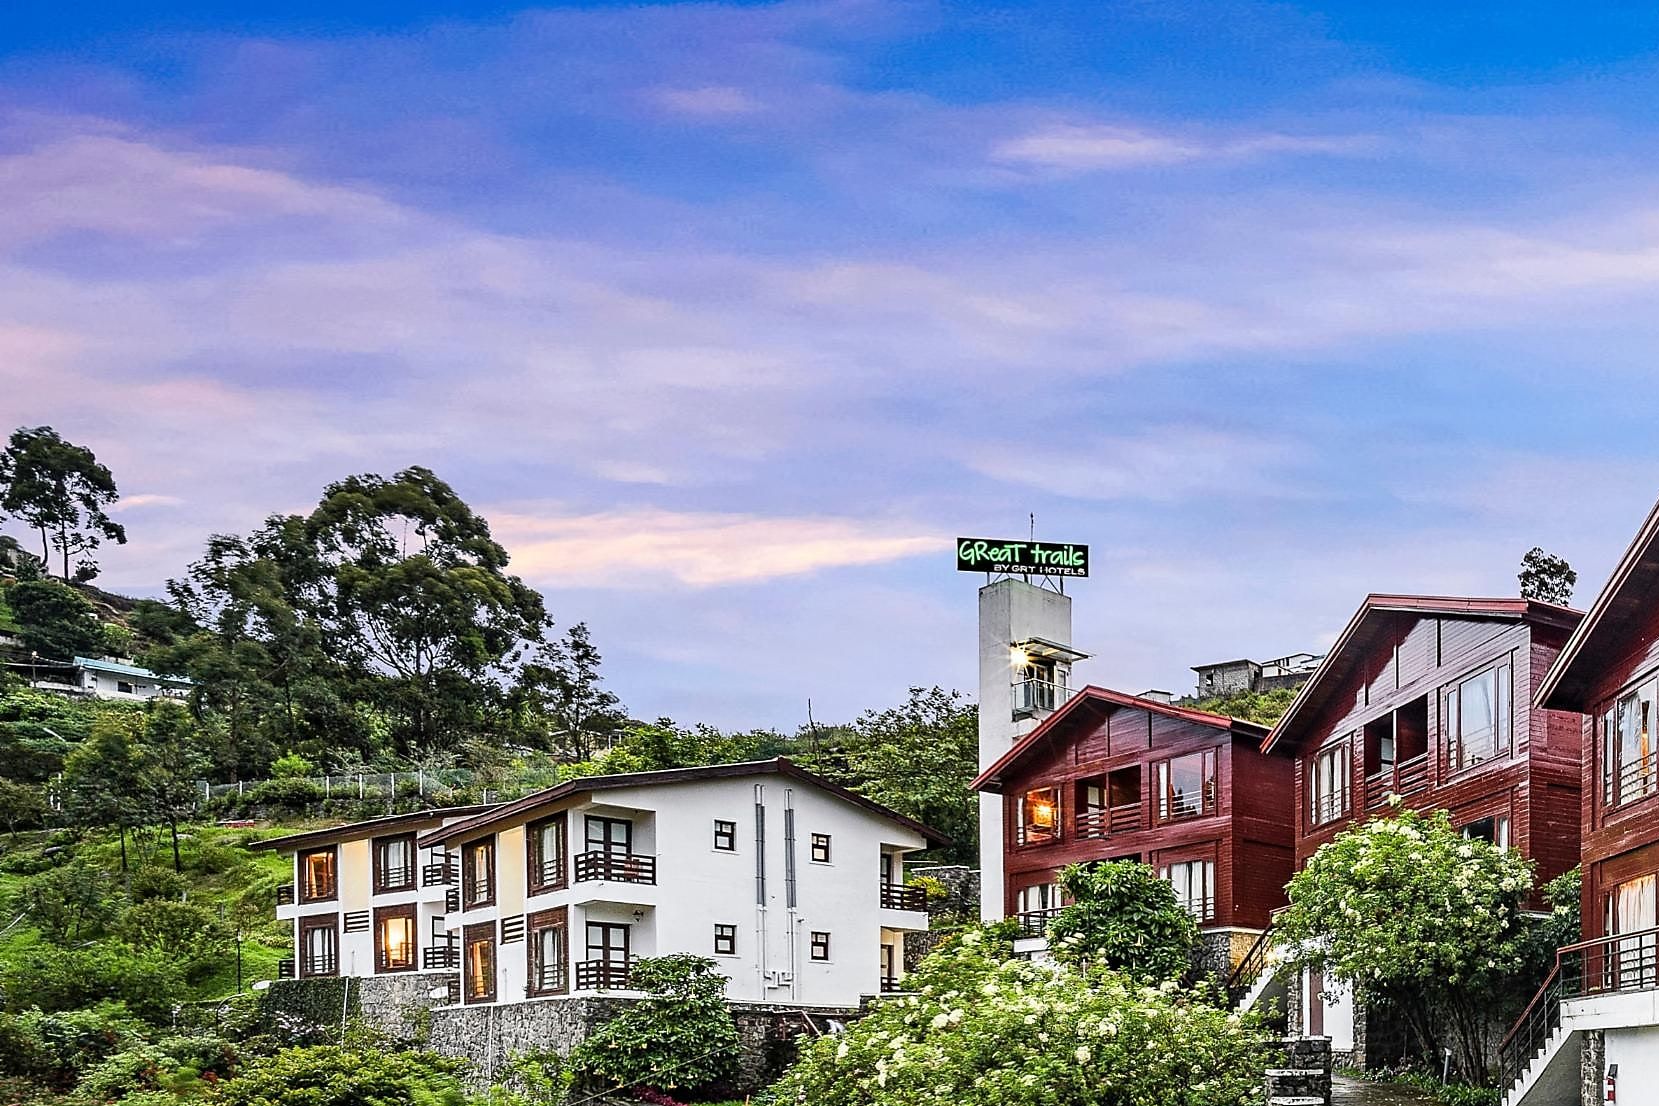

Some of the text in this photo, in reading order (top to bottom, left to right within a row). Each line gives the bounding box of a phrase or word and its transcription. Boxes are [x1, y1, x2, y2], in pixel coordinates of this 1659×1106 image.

[1030, 544, 1085, 566] trails
[1011, 565, 1036, 573] GRT
[1039, 566, 1086, 575] HOTELS
